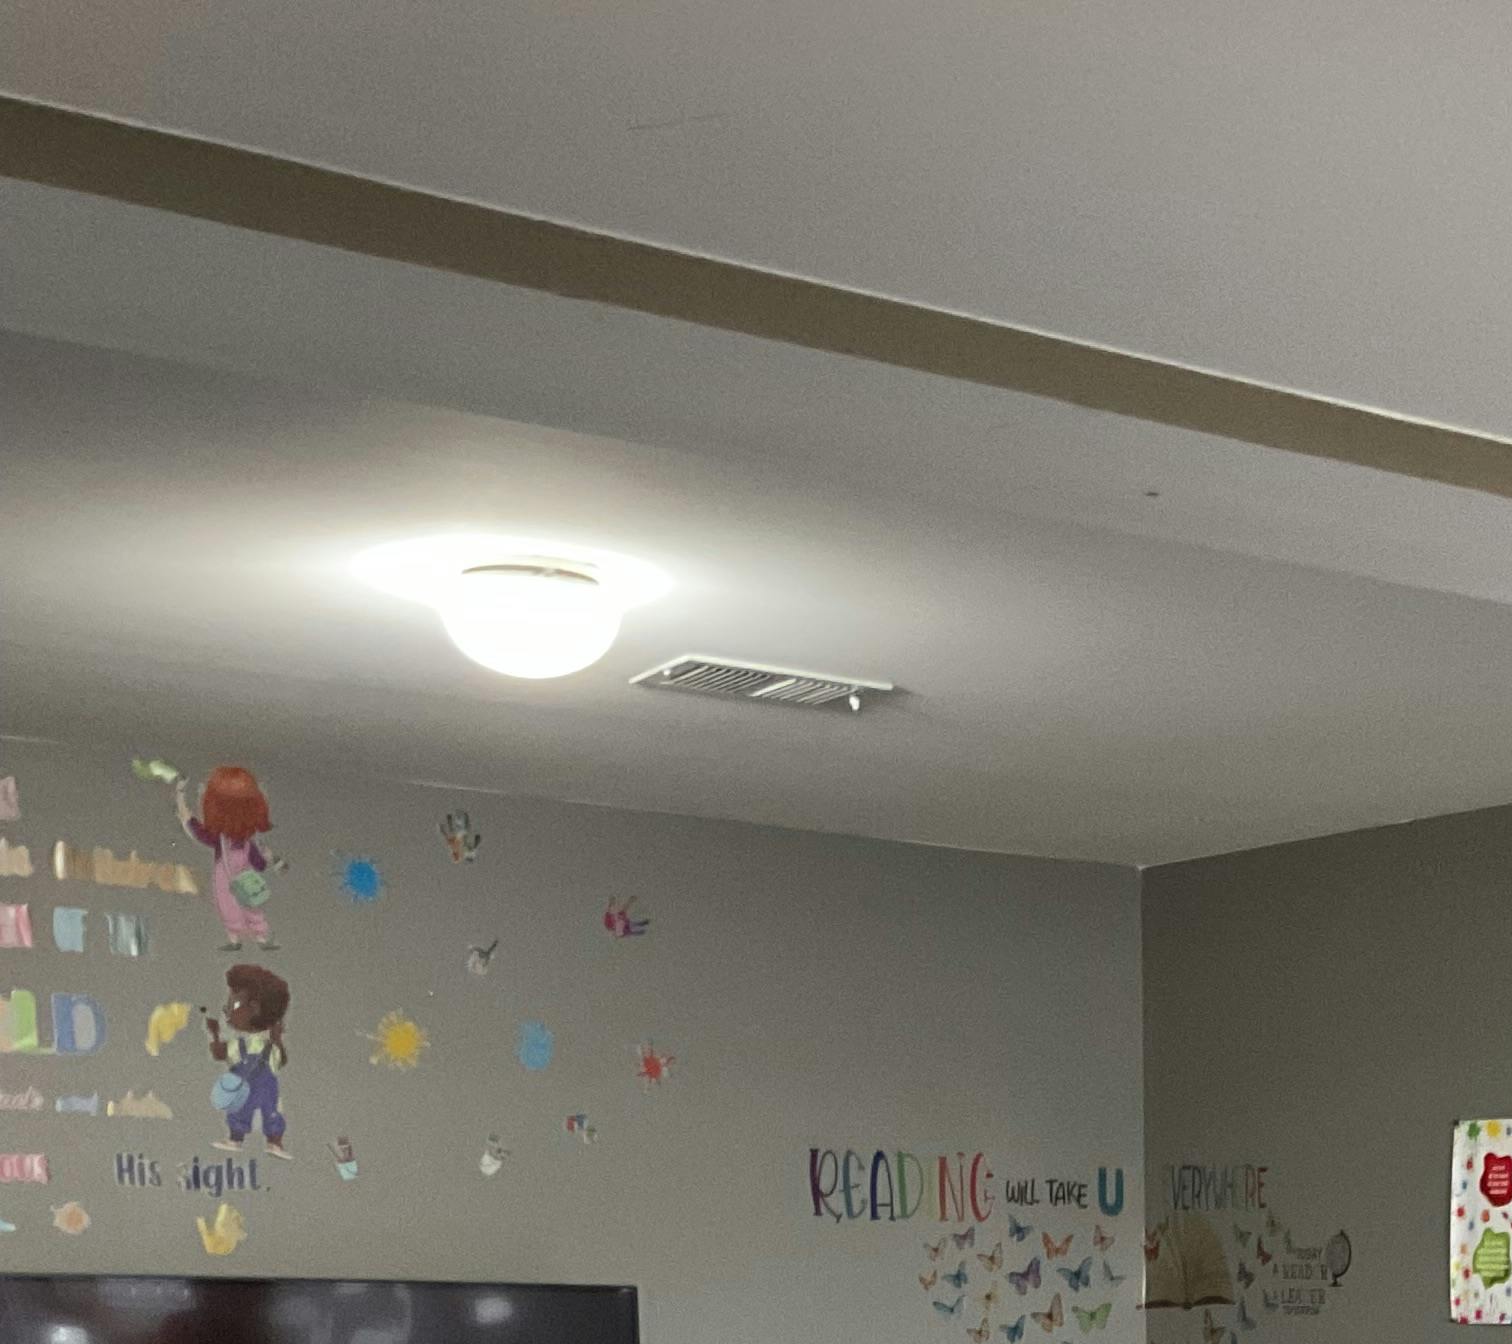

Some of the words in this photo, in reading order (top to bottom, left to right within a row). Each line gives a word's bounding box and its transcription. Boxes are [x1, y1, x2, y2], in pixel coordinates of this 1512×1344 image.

[115, 1152, 162, 1187] His
[1005, 1178, 1040, 1207] WILL
[1044, 1178, 1089, 1209] TAKE
[1097, 1166, 1125, 1218] U
